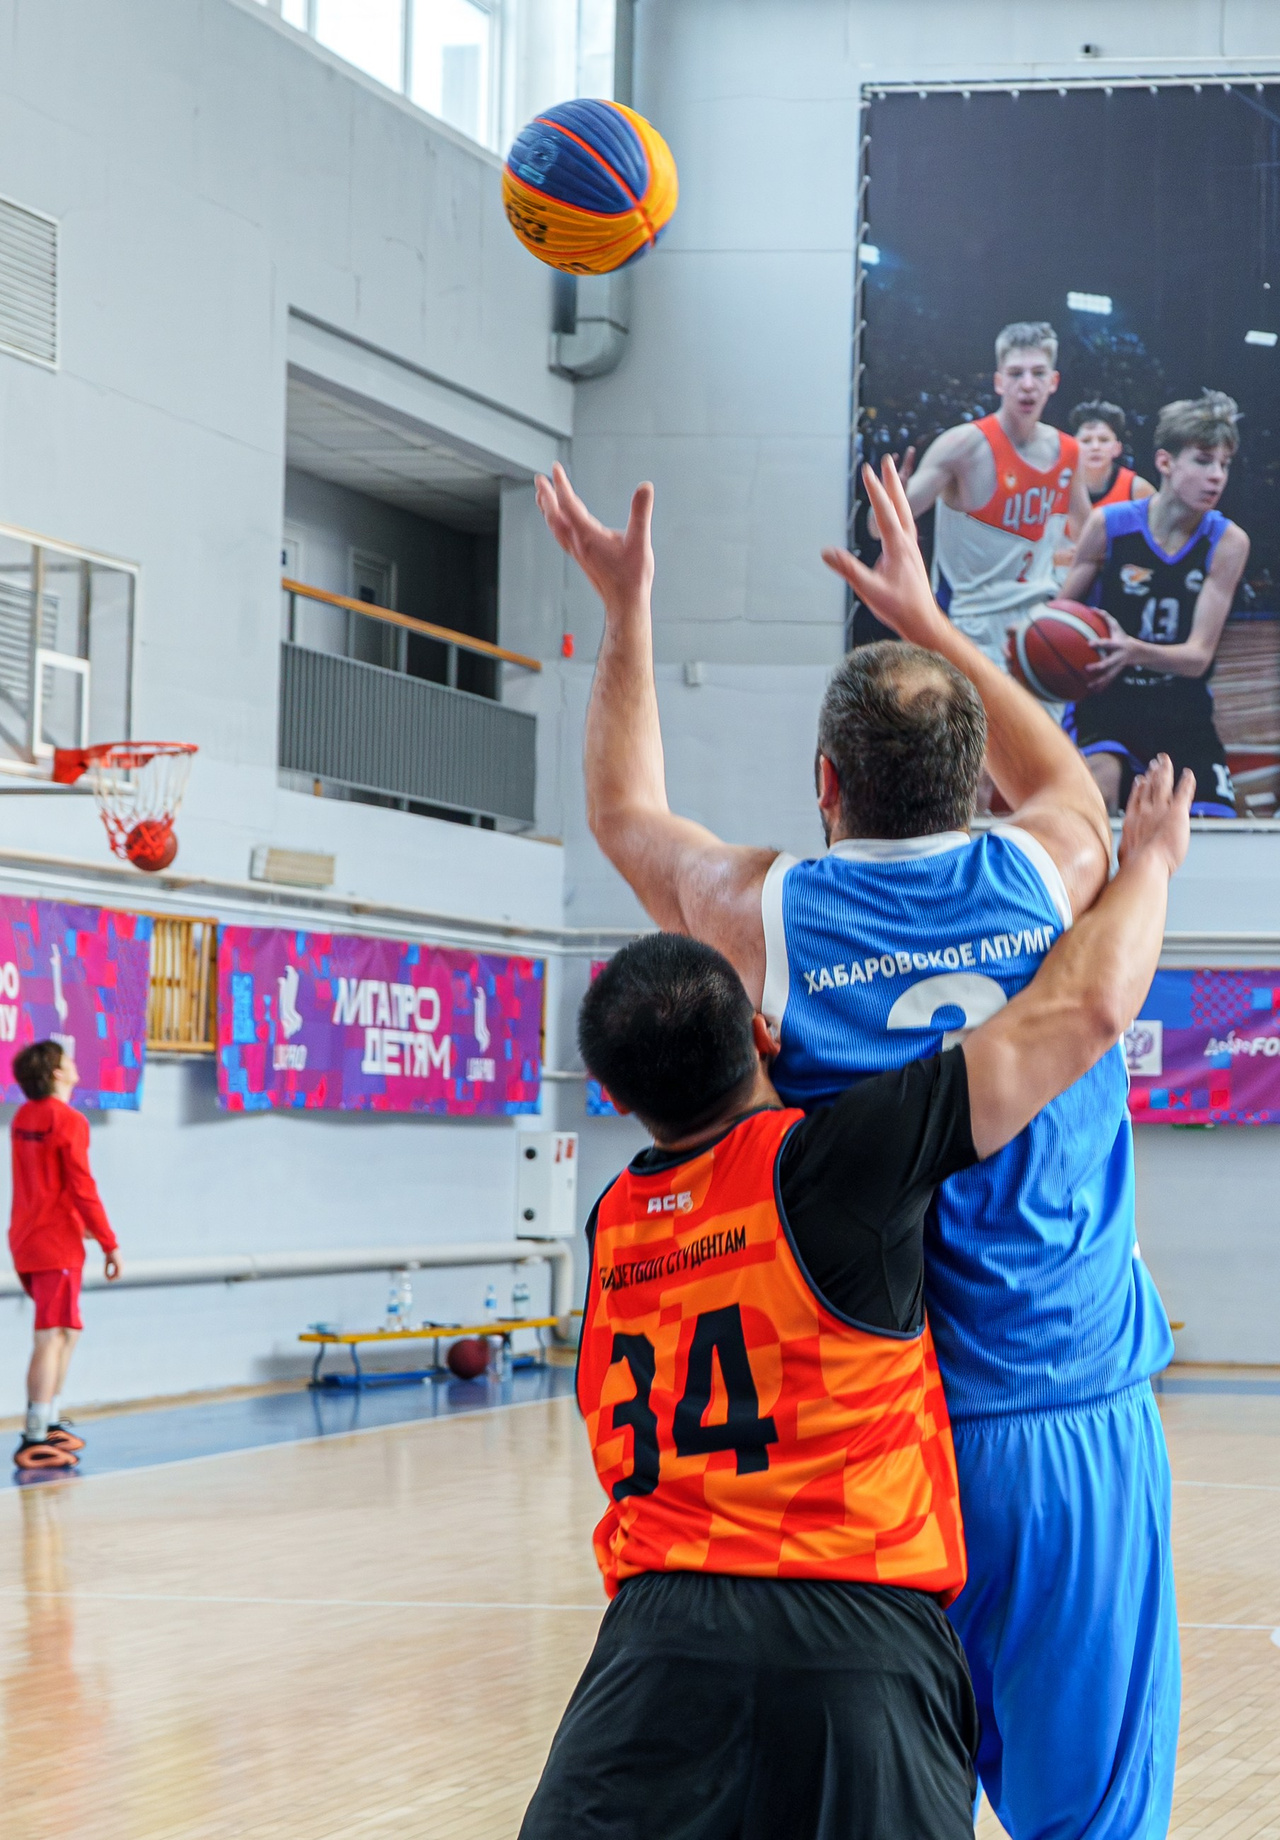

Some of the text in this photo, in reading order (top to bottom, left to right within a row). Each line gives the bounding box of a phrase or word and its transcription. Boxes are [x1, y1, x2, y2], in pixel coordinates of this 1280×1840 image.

[803, 942, 977, 995] ХАБАРОВСКОЕ
[361, 1027, 451, 1079] ДЕТЯМ
[667, 1225, 746, 1275] СТУДЕНТАМ
[611, 1303, 779, 1502] 34
